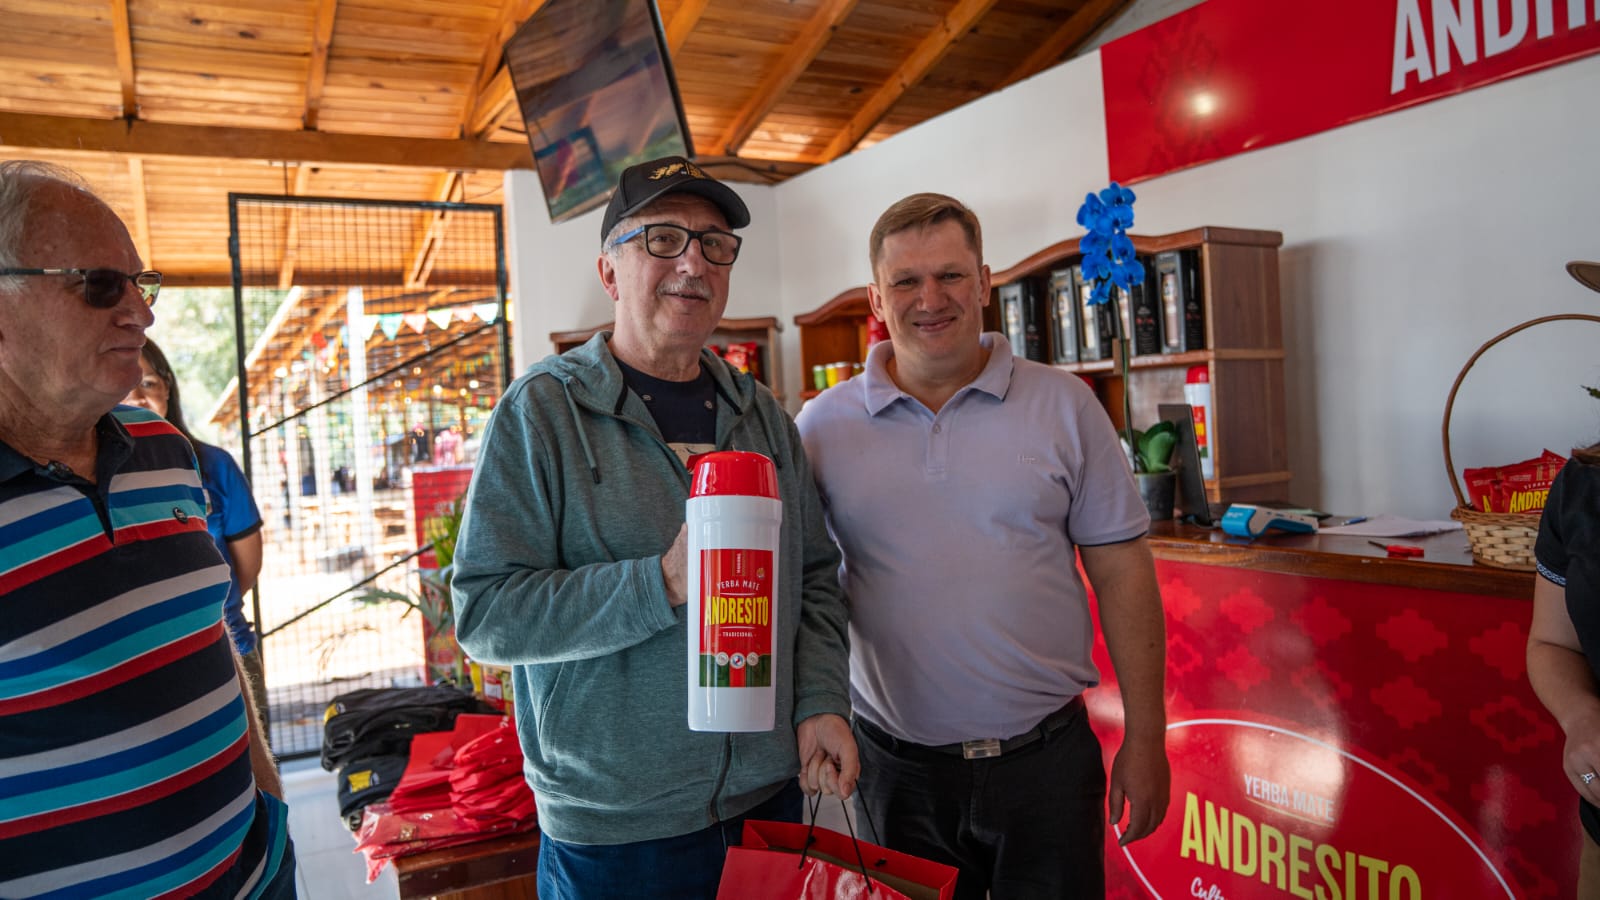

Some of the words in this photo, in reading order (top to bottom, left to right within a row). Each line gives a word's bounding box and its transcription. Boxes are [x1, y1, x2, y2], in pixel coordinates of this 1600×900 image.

[716, 580, 740, 591] YERBA
[742, 580, 761, 591] MATE
[704, 596, 769, 627] ANDRESITO
[1244, 773, 1289, 807] YERBA
[1293, 788, 1335, 823] MATE
